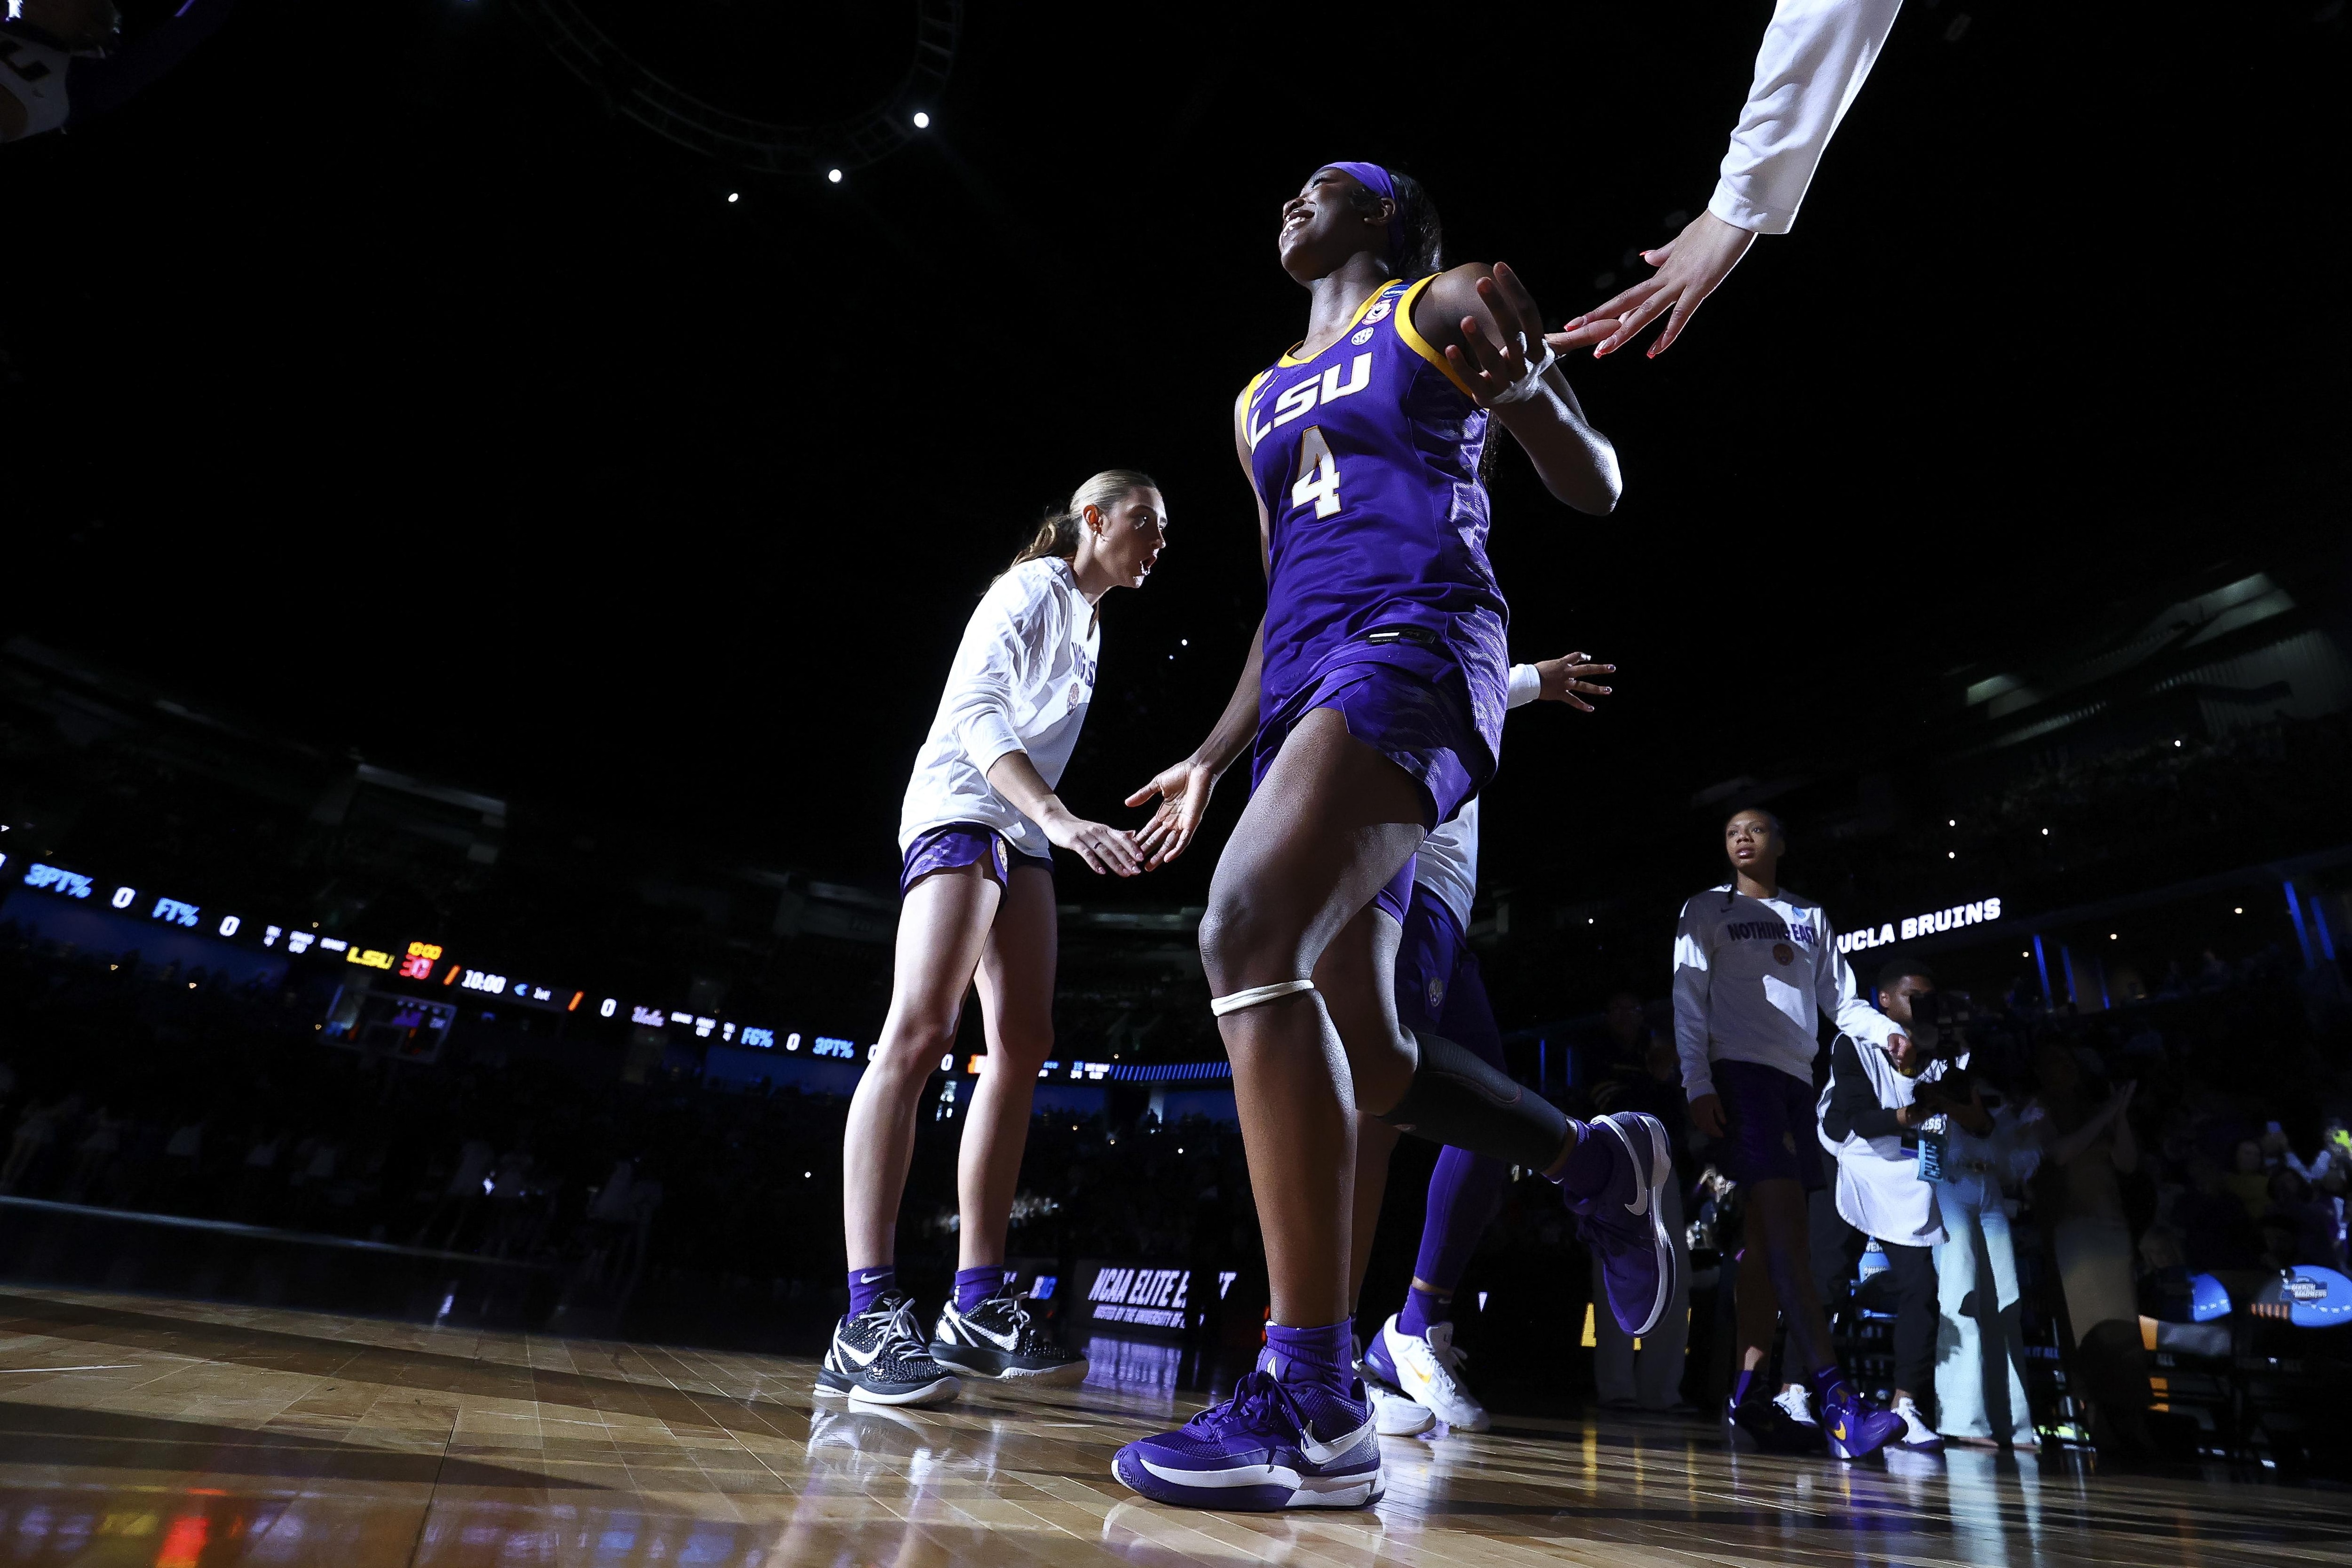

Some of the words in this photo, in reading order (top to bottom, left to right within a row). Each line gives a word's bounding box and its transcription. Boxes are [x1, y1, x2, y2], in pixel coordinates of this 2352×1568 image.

[1251, 352, 1373, 455] LSU
[1292, 425, 1342, 519] 4
[111, 887, 136, 908] 0
[219, 915, 241, 936] 0
[1727, 921, 1791, 942] NOTHING
[1836, 923, 1896, 954] UCLA
[1901, 898, 2001, 940] BRUINS
[461, 969, 507, 994] 10:00
[600, 998, 617, 1017] 0
[786, 1033, 801, 1051] 0
[1088, 1267, 1136, 1303] NCAA
[1127, 1268, 1181, 1307] ELITE
